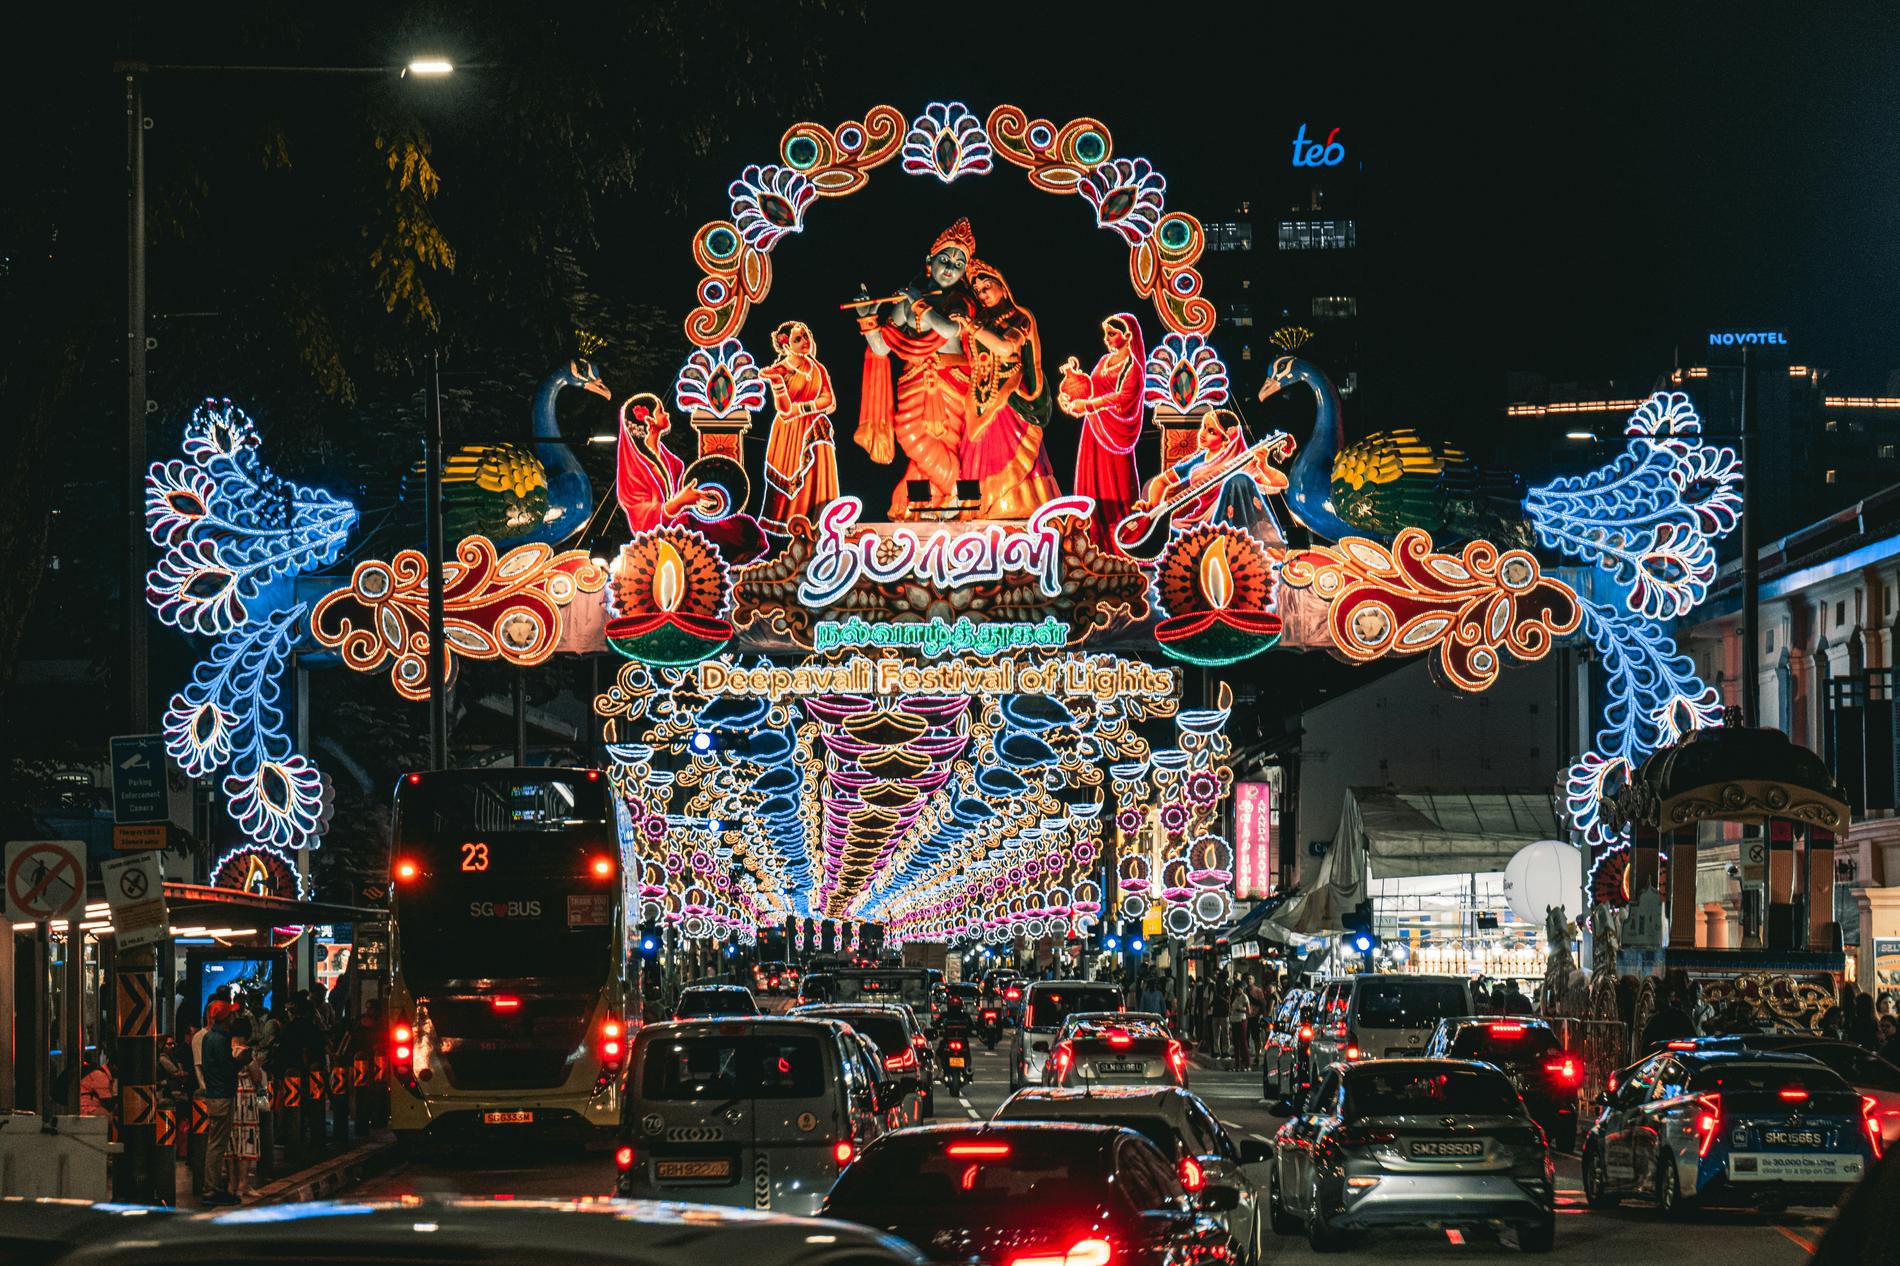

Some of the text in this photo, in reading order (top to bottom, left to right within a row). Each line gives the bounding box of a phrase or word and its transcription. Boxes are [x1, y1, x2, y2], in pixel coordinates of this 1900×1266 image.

[1709, 332, 1787, 345] NOVOTEL
[797, 496, 1096, 606] தீபாவளி
[700, 657, 1174, 703] Deepavali Festival of Lights
[461, 842, 489, 872] 23
[1257, 799, 1267, 888] ANANDA BHAVAN
[470, 901, 543, 918] SG BUS
